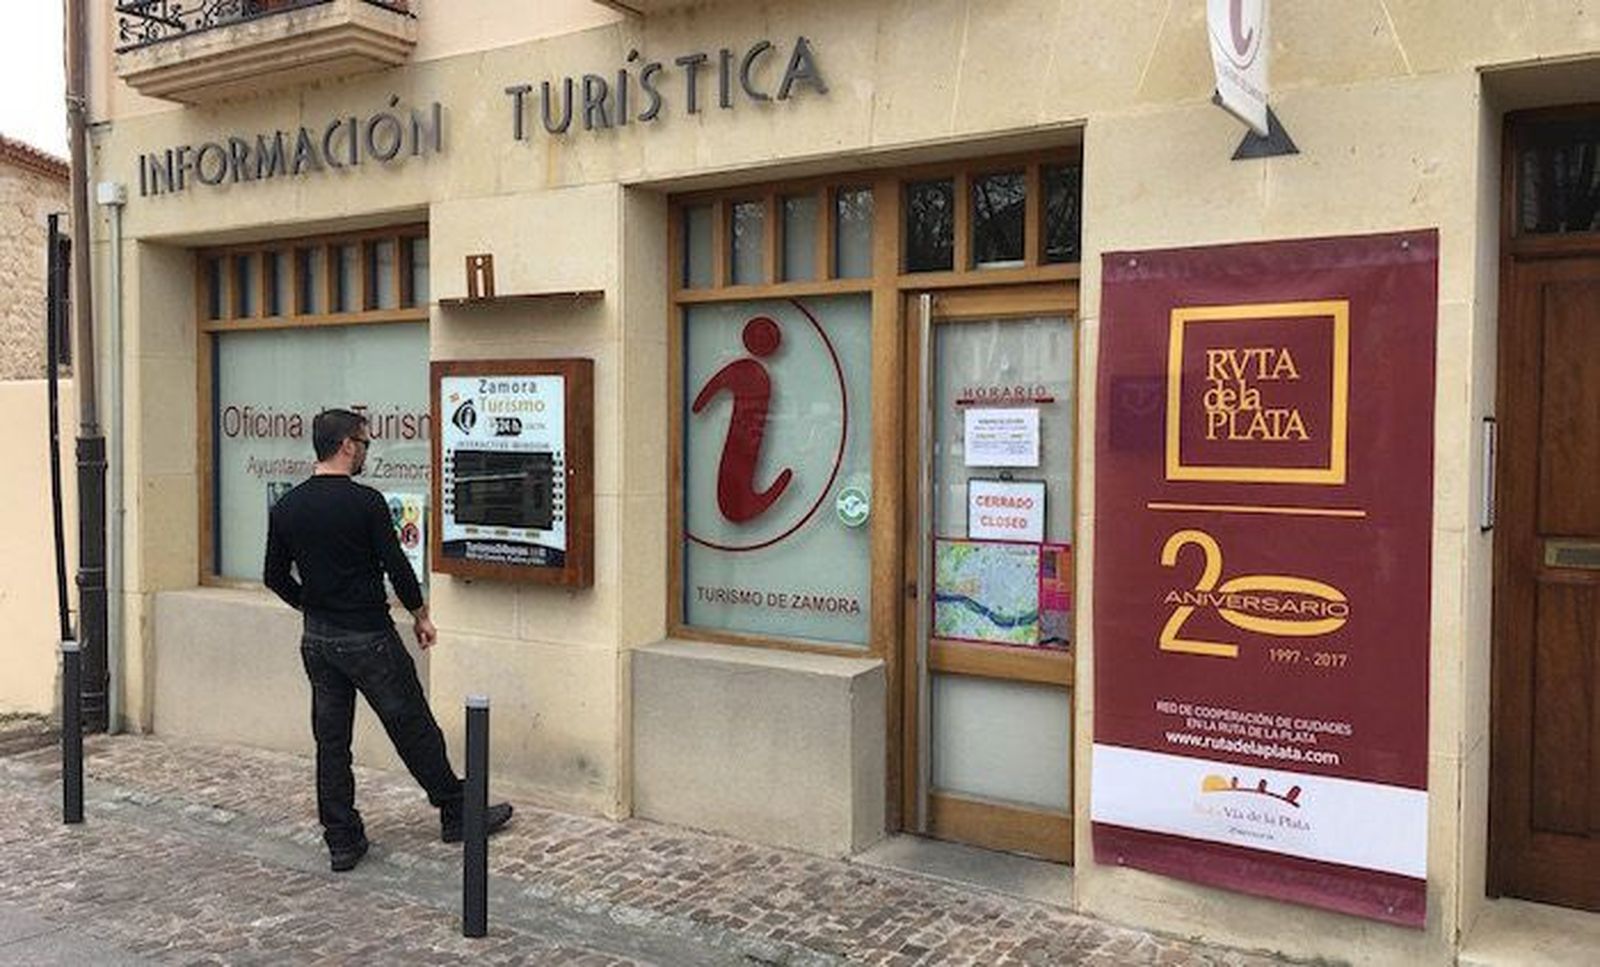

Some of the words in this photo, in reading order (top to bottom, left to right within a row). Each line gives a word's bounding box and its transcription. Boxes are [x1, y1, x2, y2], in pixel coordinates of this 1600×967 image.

[139, 93, 442, 197] INFORMACIÓN
[505, 36, 829, 140] TURÍSTICA
[1206, 348, 1300, 381] RVTA
[478, 378, 538, 394] Zamora
[963, 385, 1047, 398] HORARIO
[480, 396, 546, 413] Turismo
[223, 406, 303, 438] Oficina
[351, 404, 432, 439] Turism
[1206, 409, 1310, 440] PLATA
[975, 495, 1034, 509] CERRADO
[980, 515, 1028, 528] CLOSED
[697, 587, 763, 606] TURISMO
[767, 594, 788, 608] DE
[791, 594, 861, 613] ZAMORA
[1164, 590, 1349, 617] ANIVERSARIO
[1269, 649, 1301, 663] 1997
[1314, 653, 1348, 667] 2017
[1156, 701, 1178, 714] RED
[1179, 703, 1193, 716] DE
[1275, 715, 1293, 730] DE
[1203, 719, 1217, 731] LA
[1248, 725, 1262, 738] DE
[1263, 728, 1279, 740] LA
[1165, 731, 1340, 765] www.rutadelaplata.com
